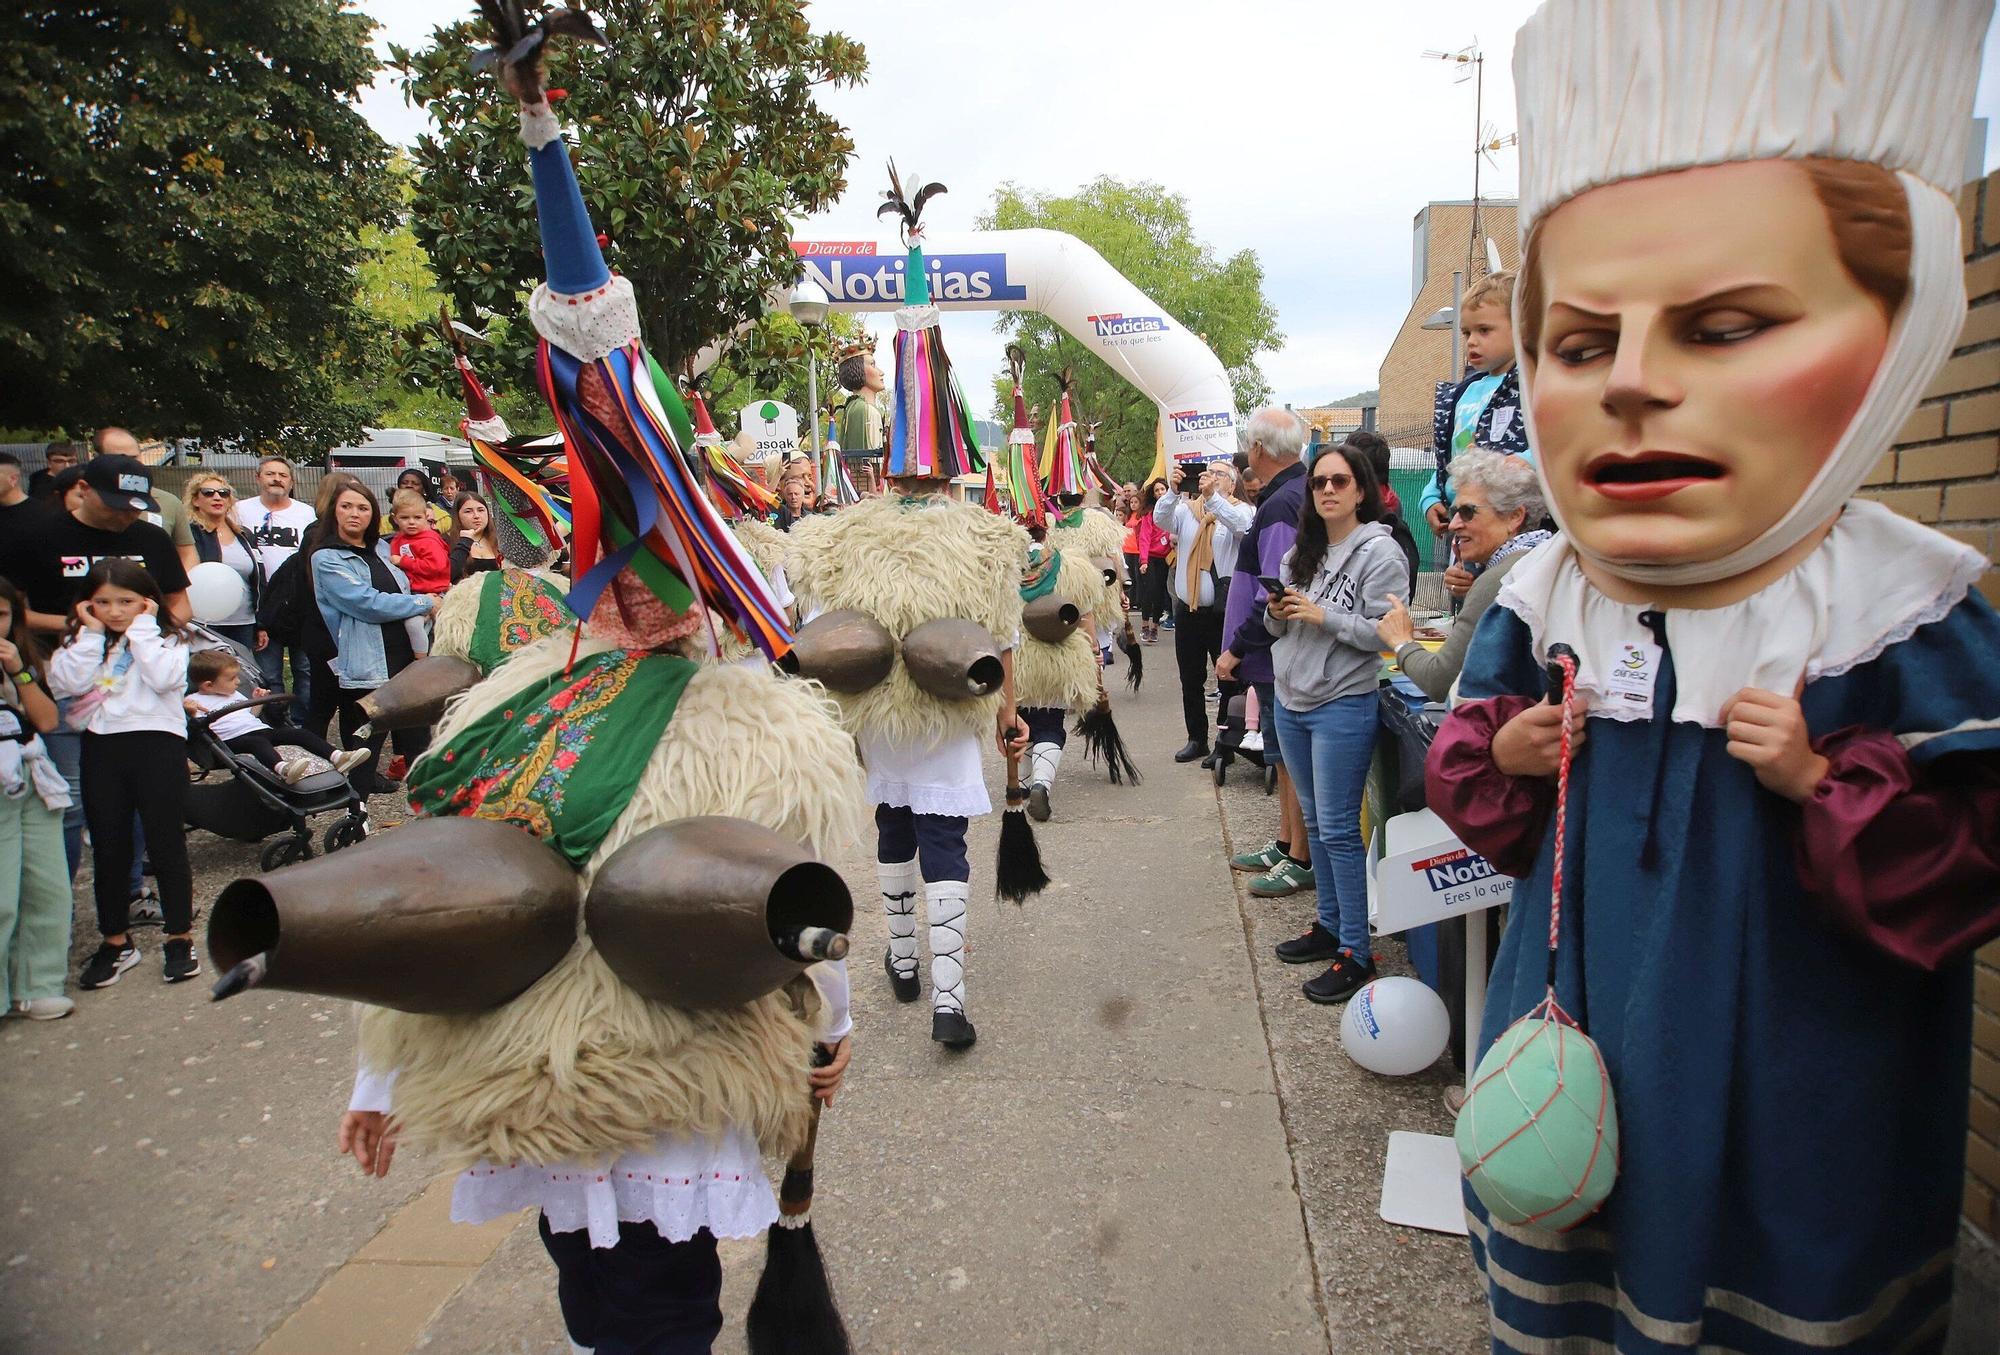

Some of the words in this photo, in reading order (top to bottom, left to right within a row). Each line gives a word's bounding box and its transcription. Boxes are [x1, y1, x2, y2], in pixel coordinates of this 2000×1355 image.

[806, 242, 852, 255] Diario
[856, 242, 873, 255] de
[802, 260, 992, 300] Notiias
[1098, 318, 1160, 336] Noticias
[1130, 337, 1144, 347] que
[1147, 334, 1161, 343] lees
[1177, 415, 1228, 432] Noticias
[1180, 434, 1193, 442] Eres
[1205, 432, 1217, 441] que
[1429, 855, 1454, 867] Diario
[1455, 851, 1465, 860] de
[1444, 891, 1471, 905] Eres
[1474, 886, 1485, 897] lo
[1491, 880, 1513, 895] que
[1360, 989, 1376, 1032] Noticias
